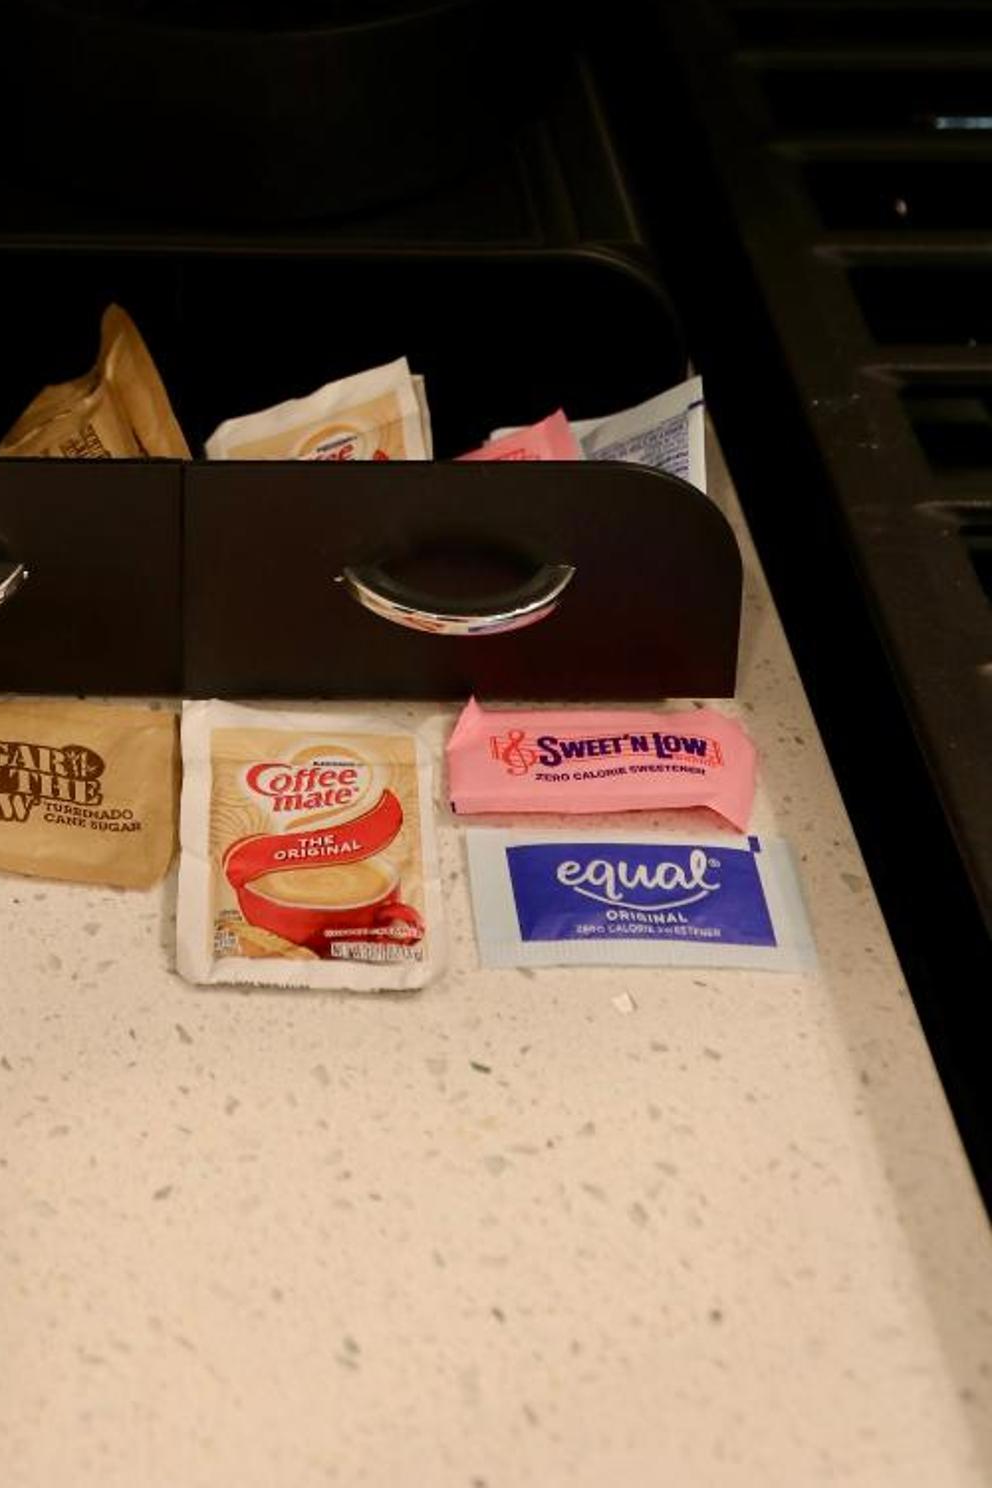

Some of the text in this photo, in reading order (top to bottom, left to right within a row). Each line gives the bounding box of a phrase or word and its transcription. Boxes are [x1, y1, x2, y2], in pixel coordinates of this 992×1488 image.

[245, 762, 358, 797] Coffee
[535, 763, 706, 783] ZERO CALORIE SWEETENER
[15, 768, 104, 806] THE
[272, 787, 353, 813] mate
[45, 802, 134, 821] TURBINADO
[43, 812, 142, 833] CANE SUGAR
[274, 840, 363, 861] ORIGINAL
[298, 834, 335, 848] THE
[558, 849, 720, 901] equal
[606, 909, 688, 924] ORIGINAL
[576, 924, 606, 934] ZERO
[608, 923, 656, 934] CALORIE
